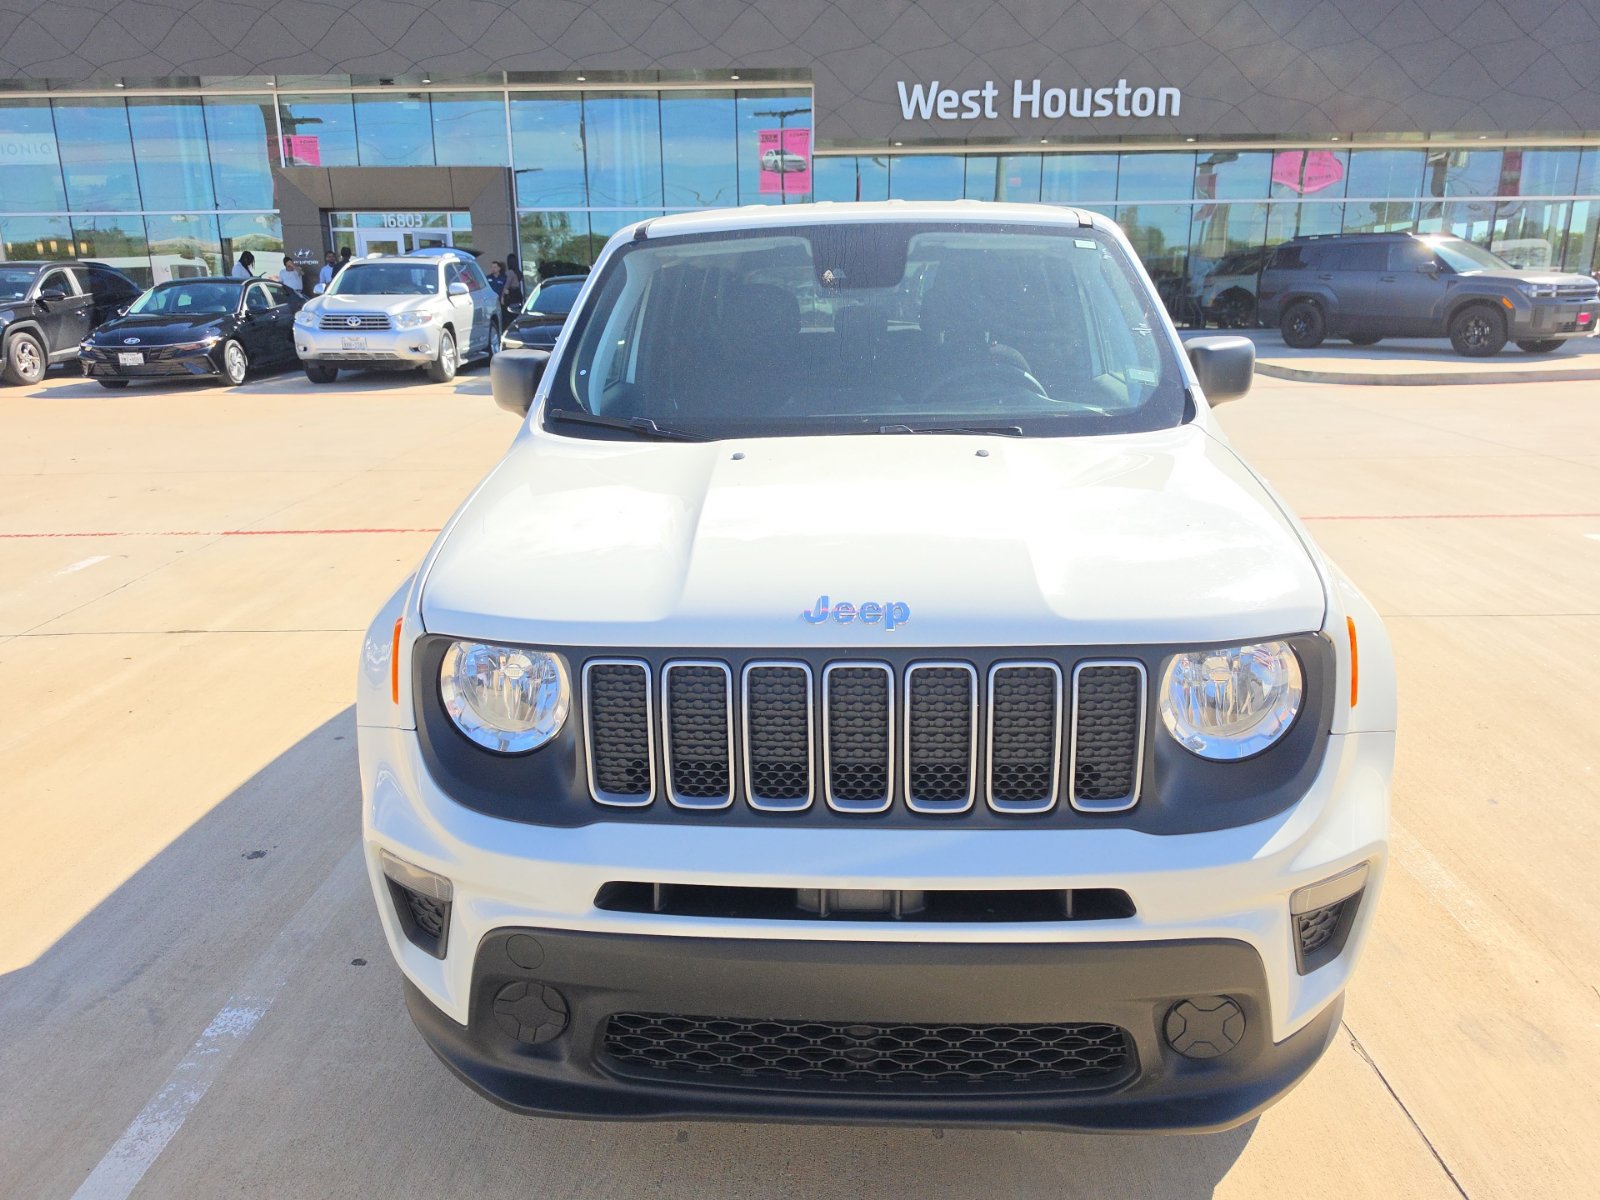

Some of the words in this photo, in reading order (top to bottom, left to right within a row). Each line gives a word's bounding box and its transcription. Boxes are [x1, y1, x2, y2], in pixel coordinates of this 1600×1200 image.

[897, 80, 999, 120] West
[1012, 78, 1181, 119] Houston
[1, 142, 52, 156] IONIQ
[382, 213, 423, 228] 16803
[802, 595, 911, 631] Jeep
